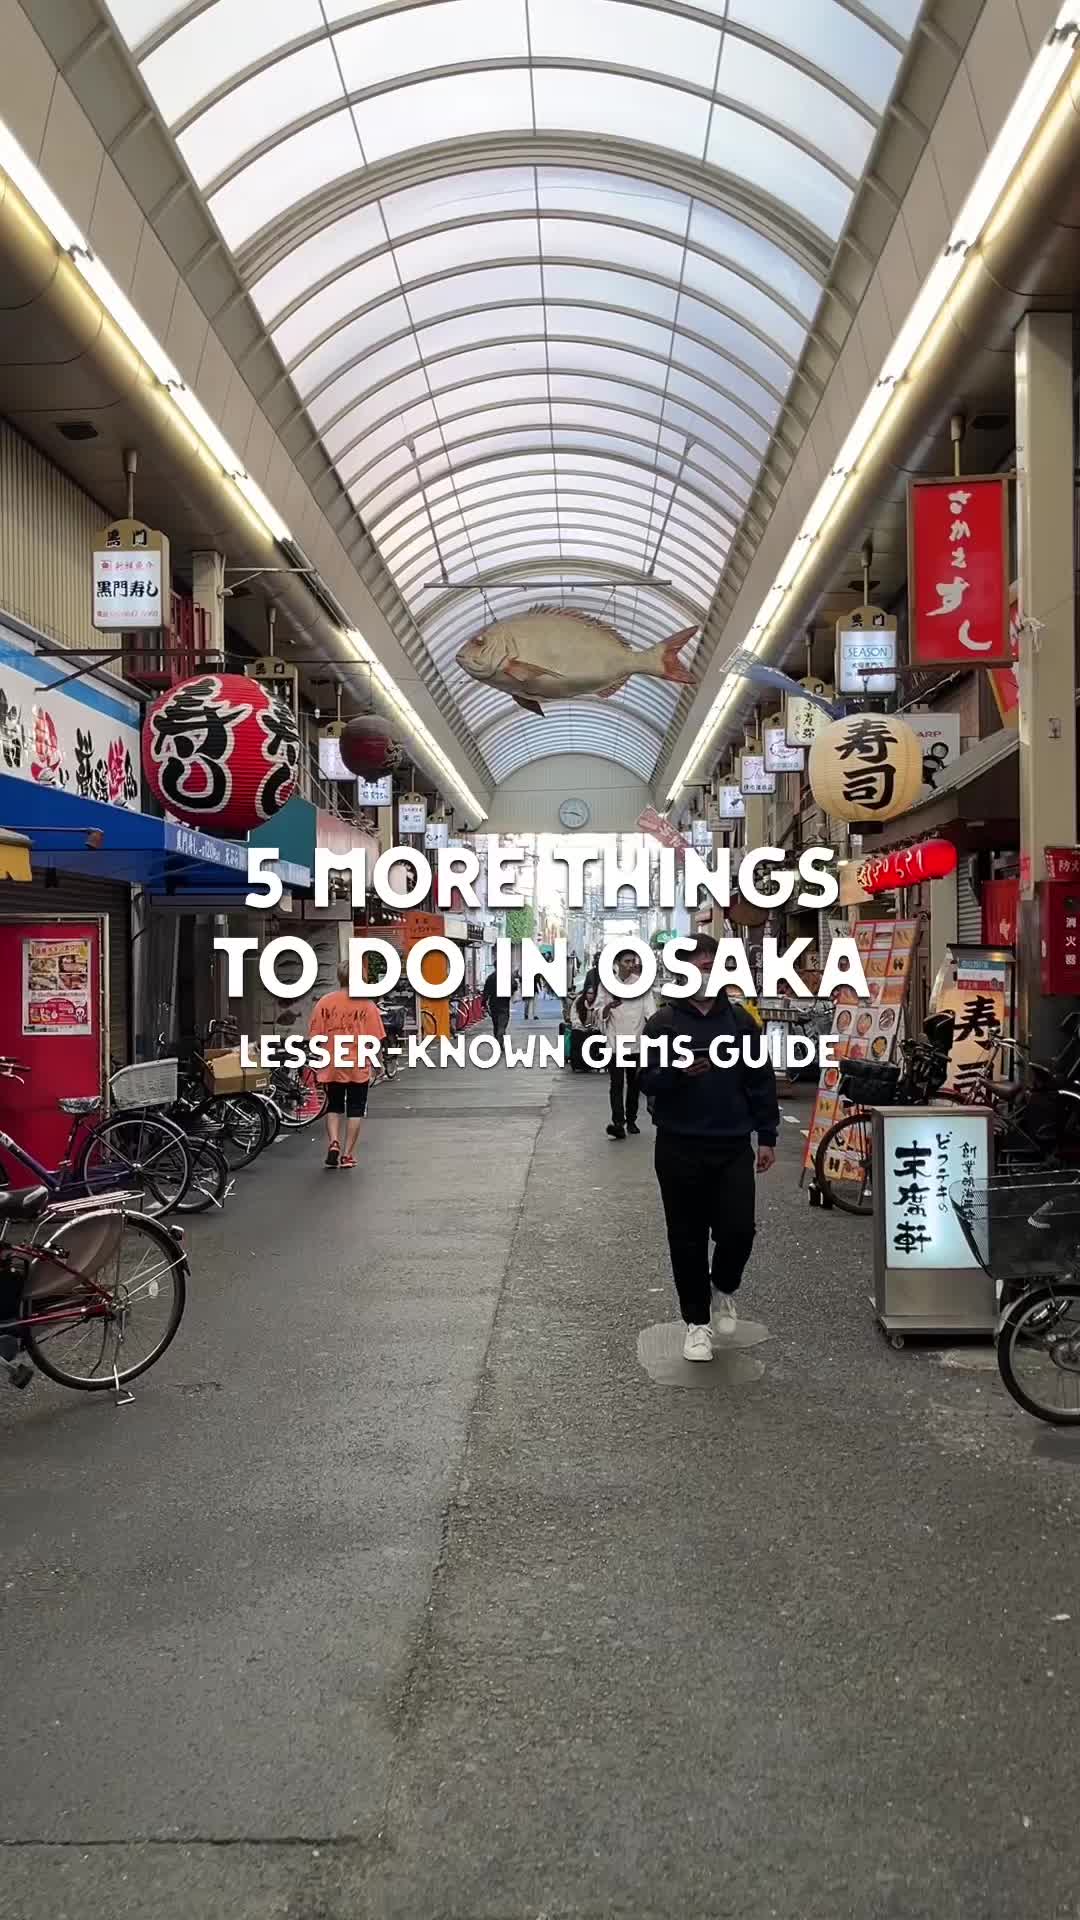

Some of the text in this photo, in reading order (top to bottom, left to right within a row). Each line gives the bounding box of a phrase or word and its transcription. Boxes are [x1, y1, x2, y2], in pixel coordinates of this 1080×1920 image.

[97, 580, 159, 598] 黒門寿し
[848, 647, 888, 657] SEASON
[835, 718, 899, 809] 寿司
[1065, 916, 1077, 965] 消火器
